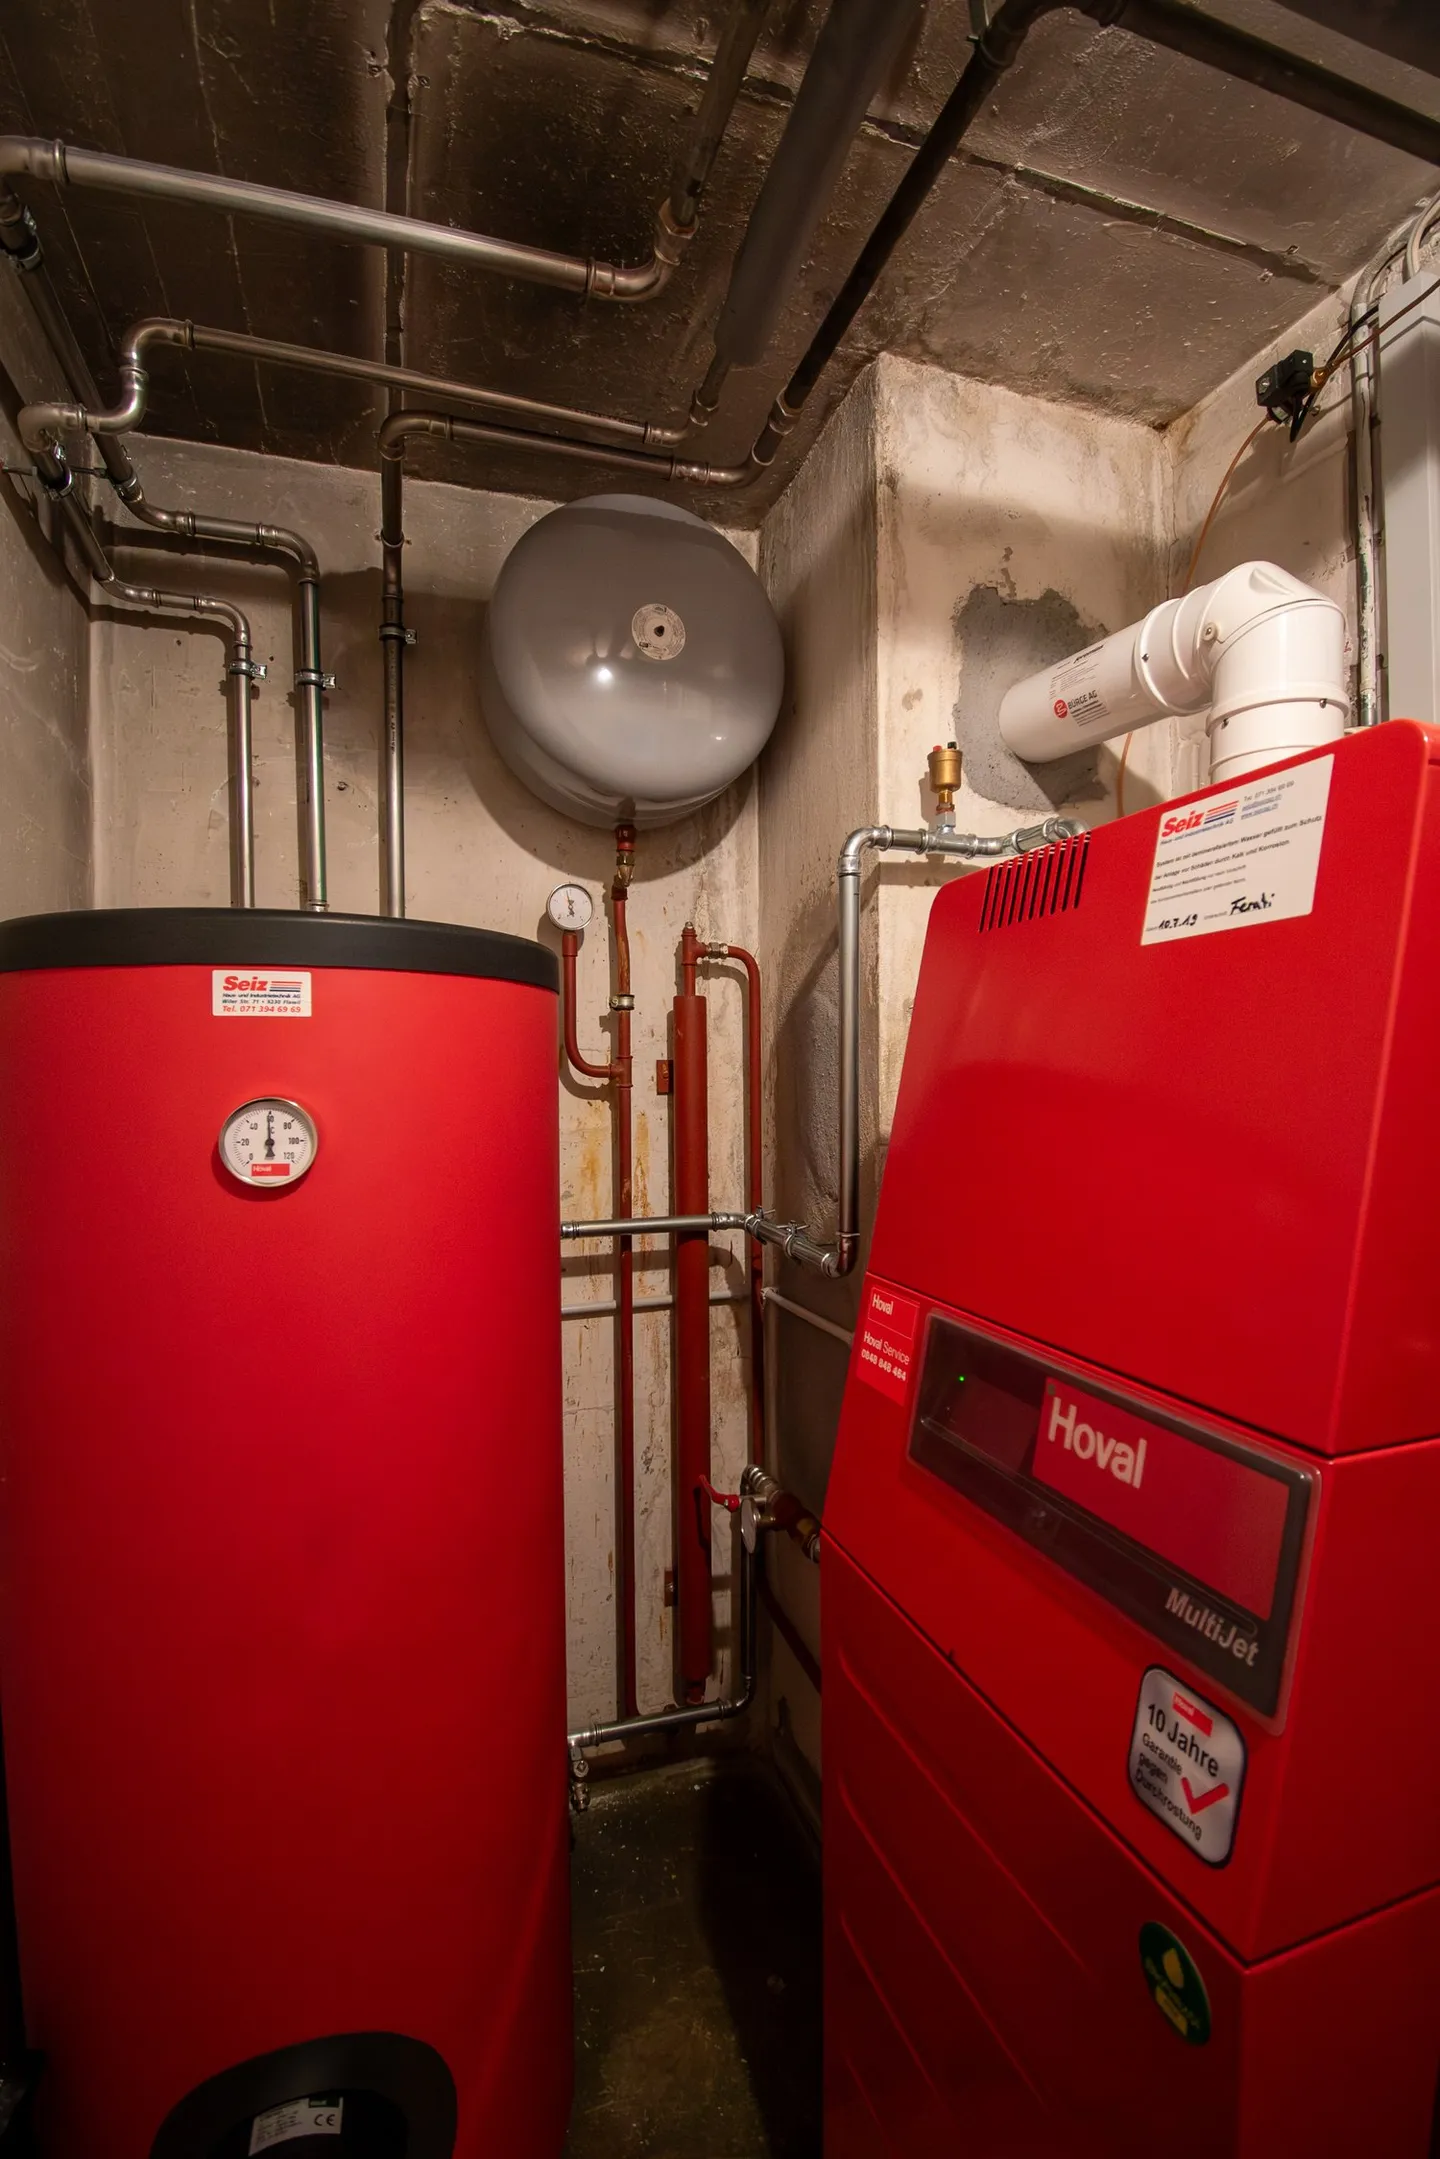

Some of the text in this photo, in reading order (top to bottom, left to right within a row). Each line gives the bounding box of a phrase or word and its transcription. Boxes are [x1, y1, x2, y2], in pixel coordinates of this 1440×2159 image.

[1162, 811, 1204, 837] Seiz
[1240, 833, 1261, 842] Wasser
[1299, 816, 1322, 826] Schutz
[1258, 840, 1289, 852] Korrosion
[223, 976, 268, 991] Seiz
[241, 1138, 249, 1146] 20
[872, 1294, 893, 1315] Hoval
[861, 1349, 878, 1365] 0848
[878, 1358, 891, 1373] 848
[864, 1331, 910, 1365] Hoval Service
[1048, 1397, 1148, 1489] Hoval
[1165, 1587, 1259, 1667] MultiJet
[1148, 1703, 1218, 1777] 10 Jahre
[1142, 1733, 1182, 1775] Garantie
[1136, 1768, 1202, 1842] Durchrostung
